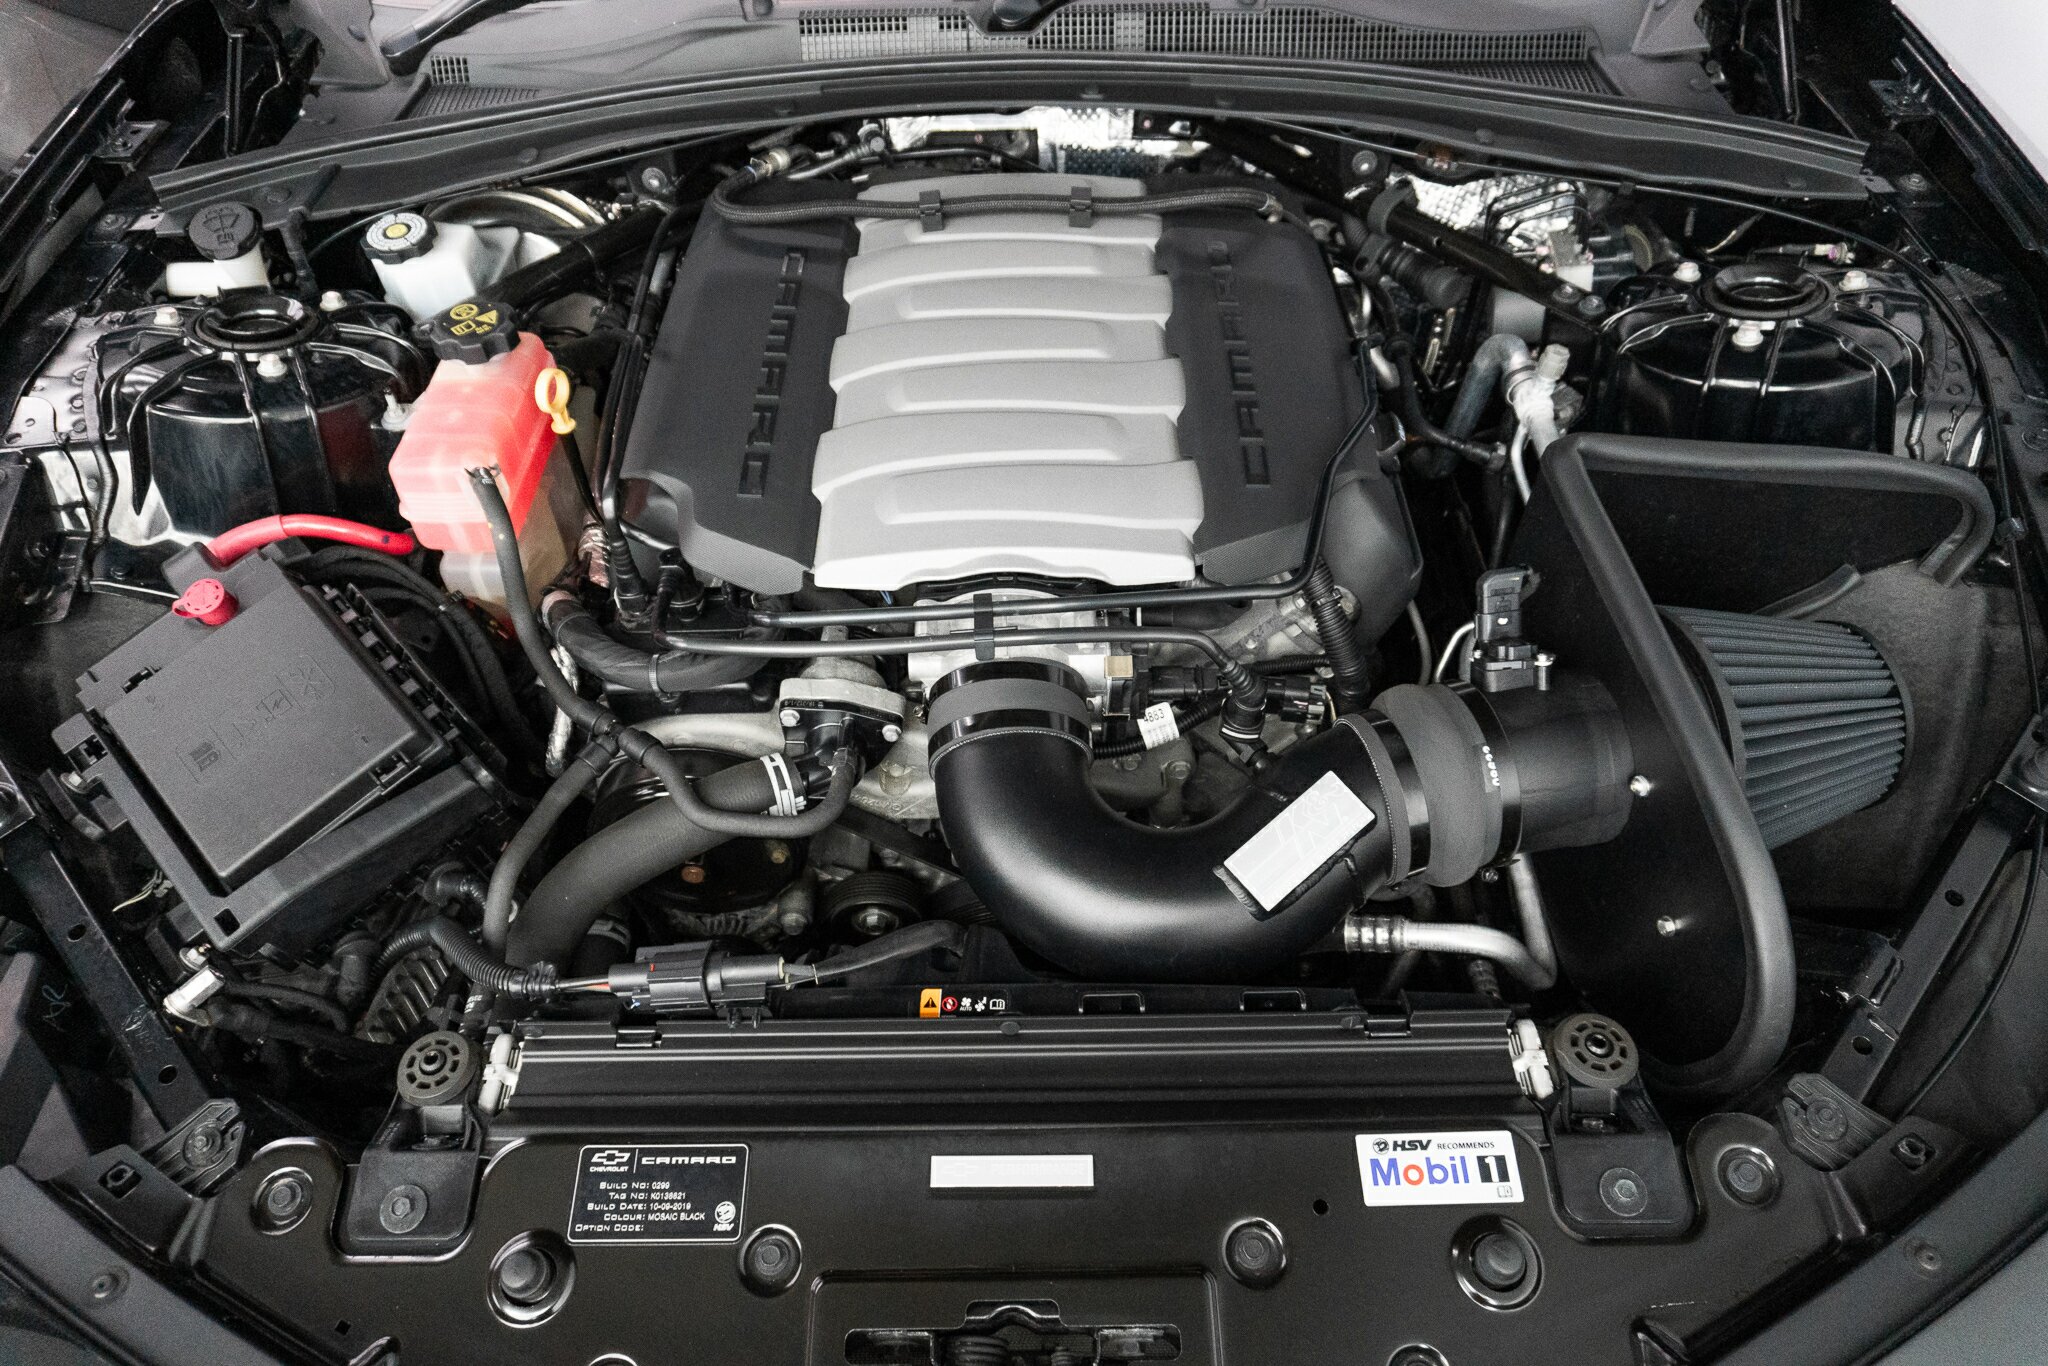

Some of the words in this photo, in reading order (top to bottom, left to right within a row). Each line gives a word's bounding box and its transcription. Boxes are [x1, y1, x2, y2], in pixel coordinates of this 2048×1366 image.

[736, 251, 806, 499] CAMARO
[1392, 1139, 1432, 1152] HSV
[1436, 1141, 1495, 1150] RECOMMENDS
[641, 1156, 736, 1165] CAMARO
[1369, 1155, 1470, 1187] Mobil
[609, 1192, 626, 1200] TAG
[648, 1212, 678, 1221] MOSAIC
[680, 1212, 705, 1221] BLACK
